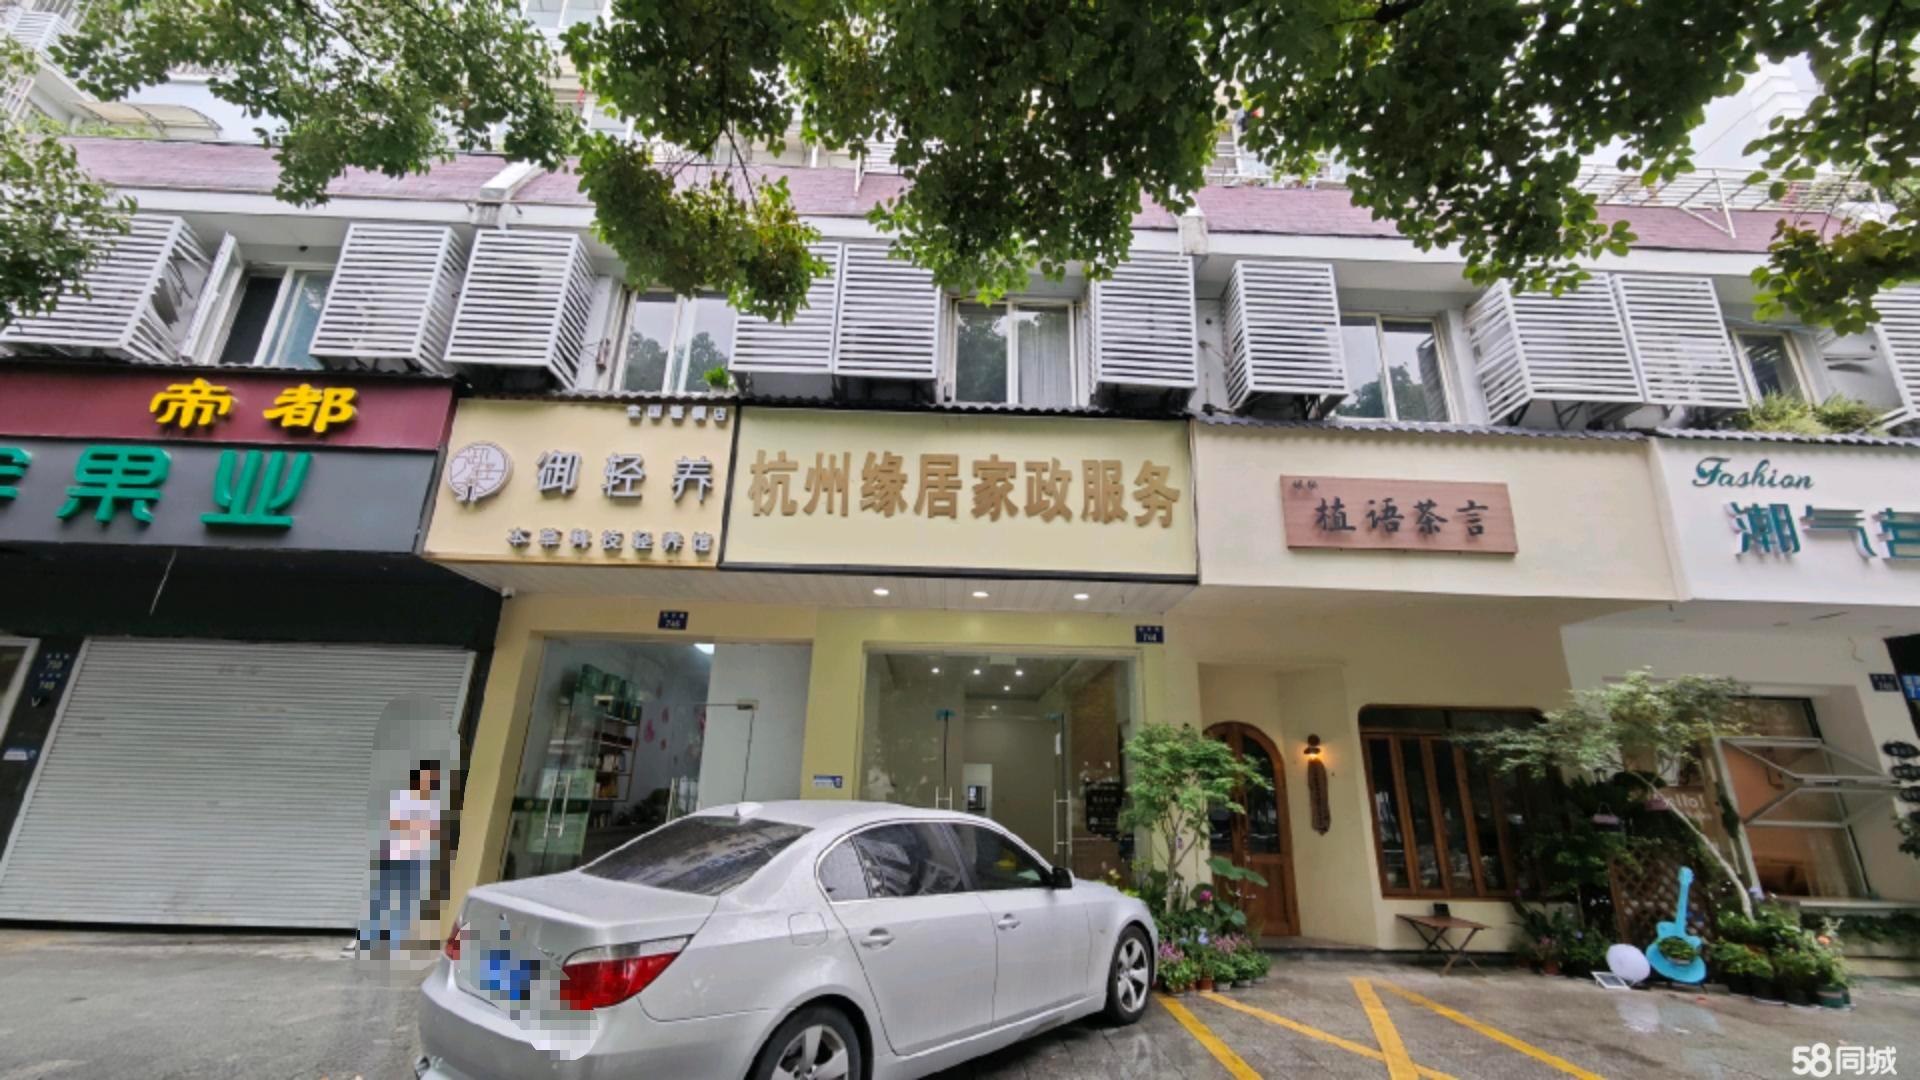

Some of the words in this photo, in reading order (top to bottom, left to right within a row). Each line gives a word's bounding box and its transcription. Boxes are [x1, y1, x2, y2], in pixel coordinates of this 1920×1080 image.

[150, 377, 358, 433] 帝都
[536, 450, 713, 502] 御轻养
[747, 449, 1181, 529] 杭州缘居家政服务
[1692, 456, 1814, 489] Fashion
[1314, 496, 1489, 537] 植语茶言
